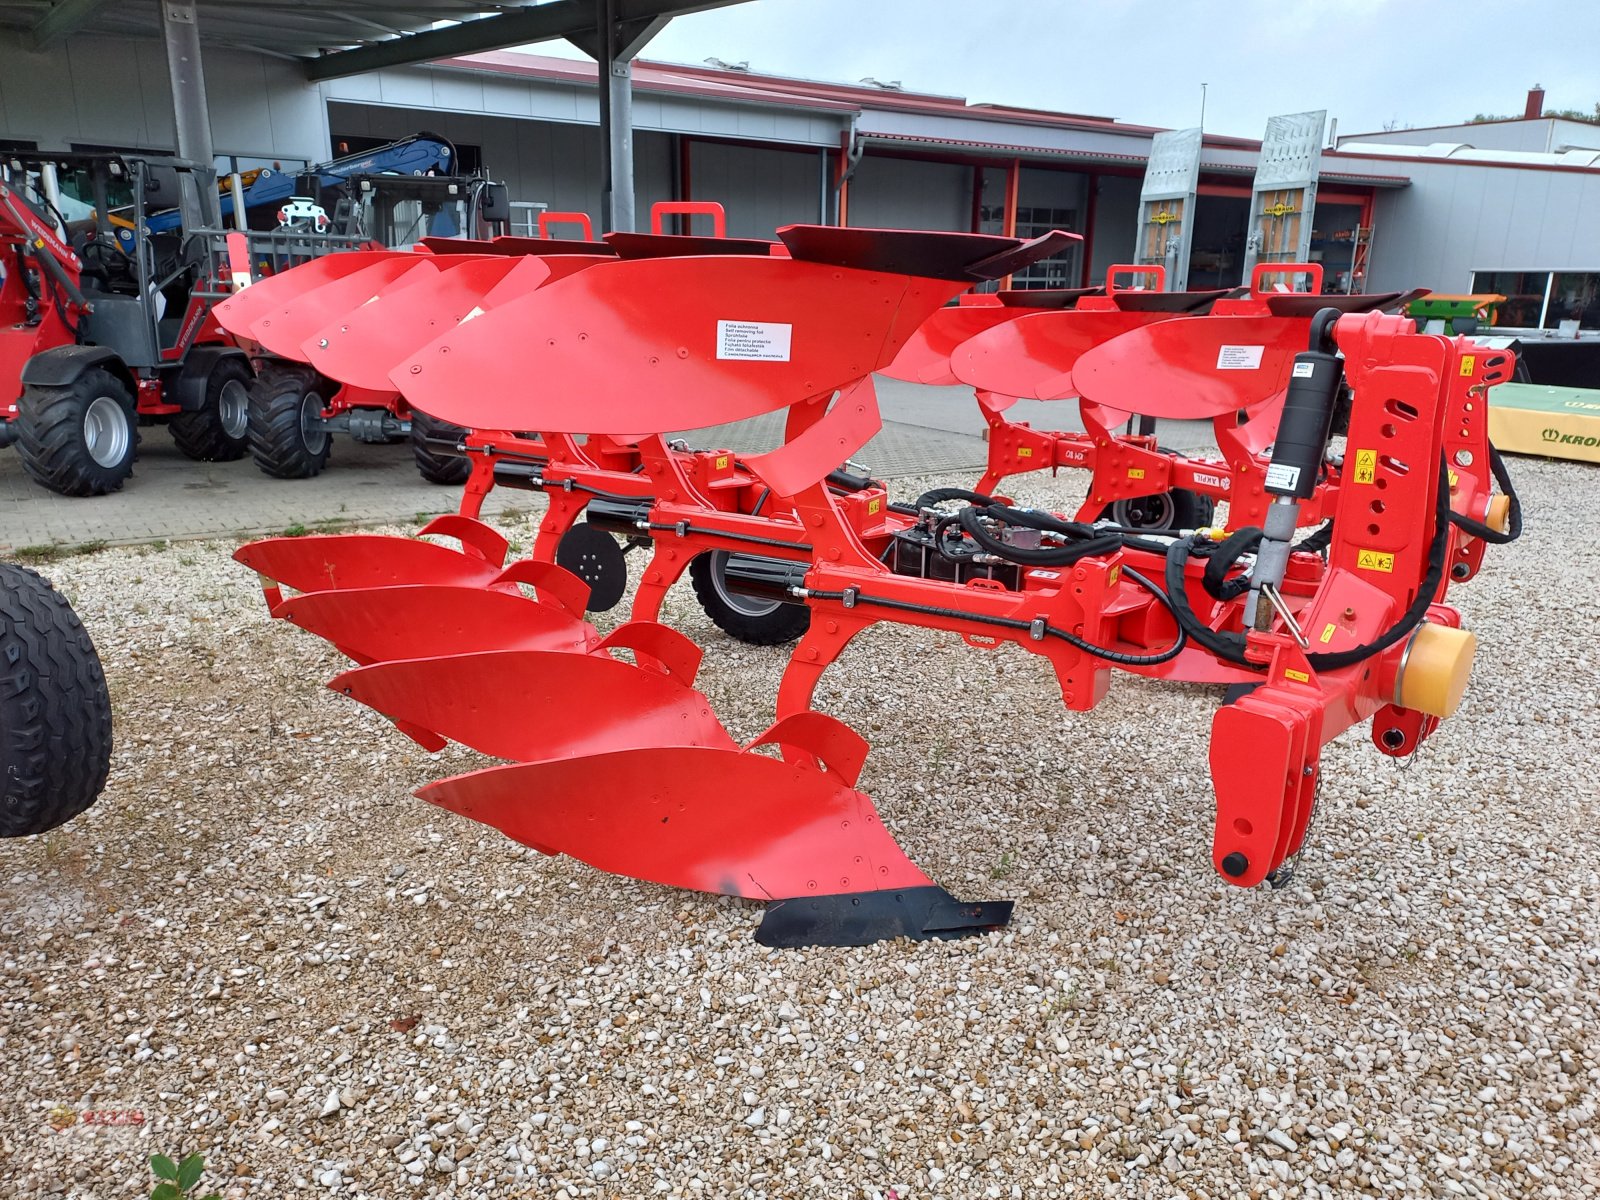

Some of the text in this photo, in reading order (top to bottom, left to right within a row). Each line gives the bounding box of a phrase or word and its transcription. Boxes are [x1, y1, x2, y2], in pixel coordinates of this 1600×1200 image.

[31, 220, 68, 258] WEIDEMANN
[179, 305, 202, 348] WEIDEMANN
[1196, 475, 1217, 485] AKPIL
